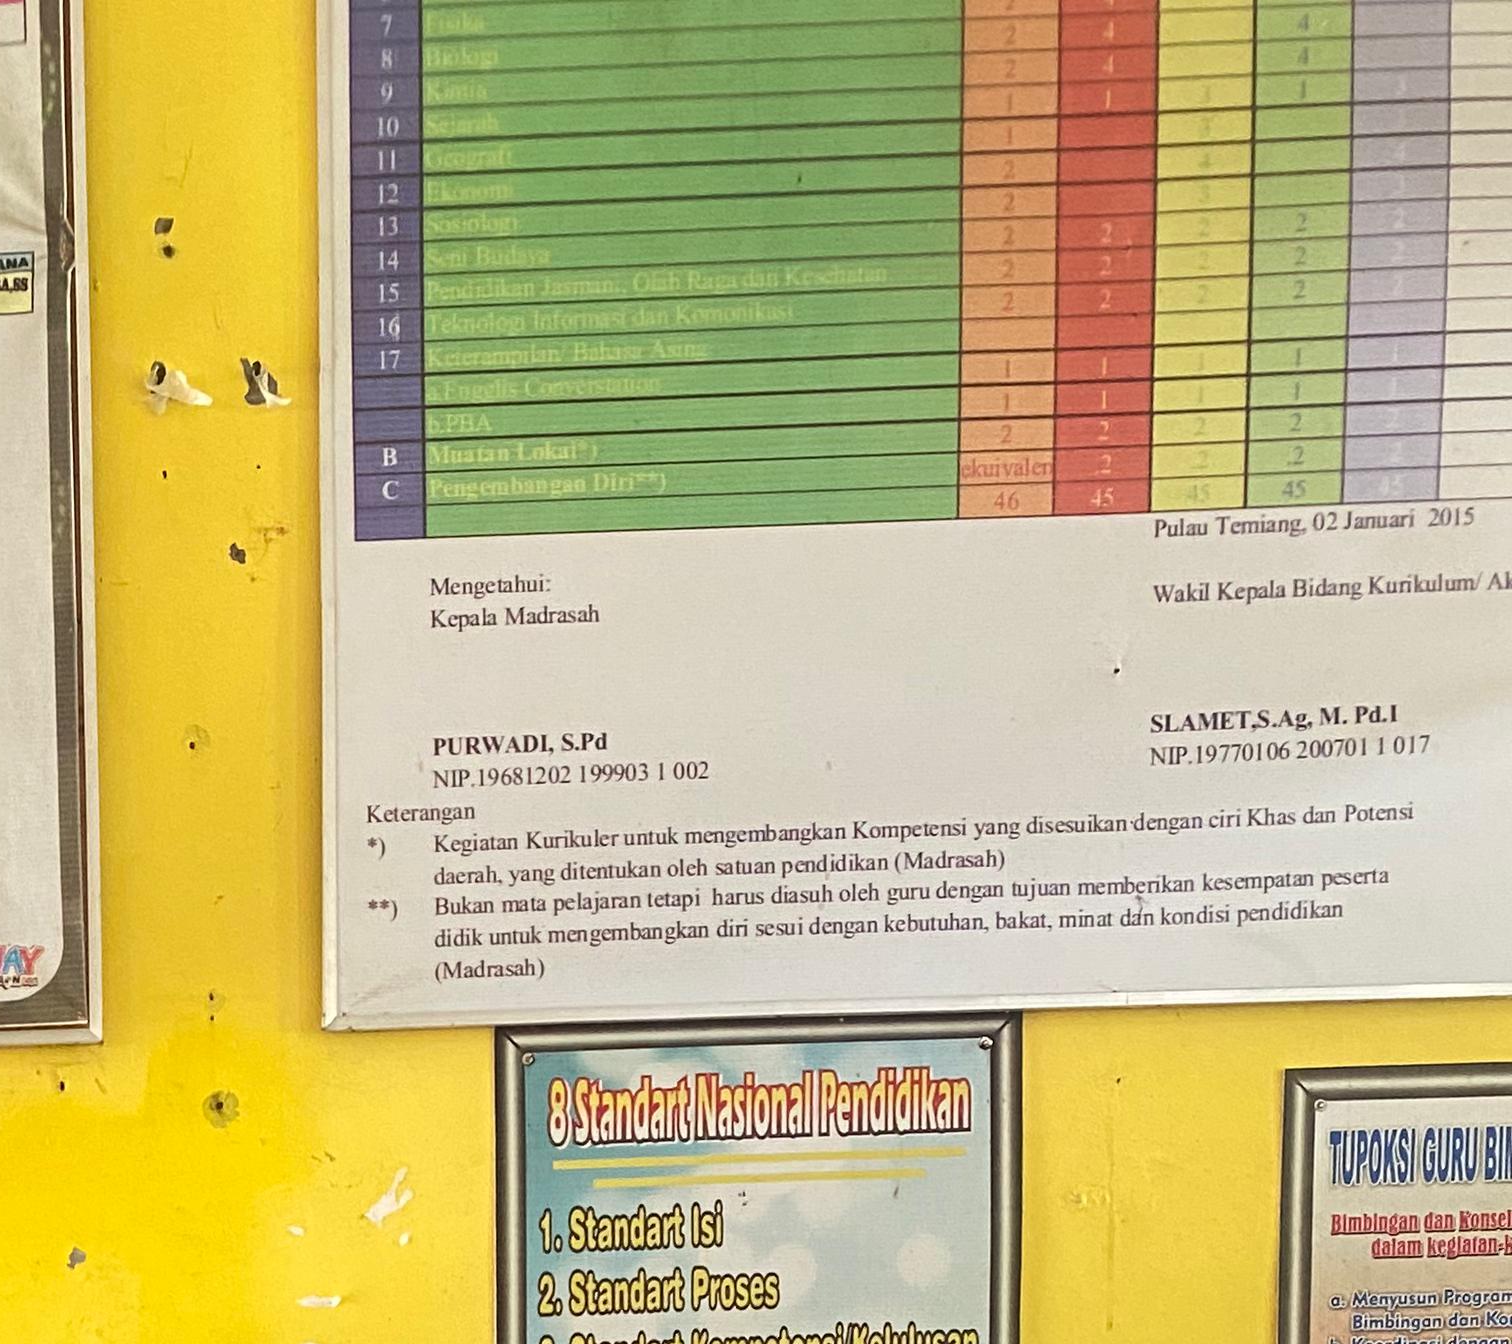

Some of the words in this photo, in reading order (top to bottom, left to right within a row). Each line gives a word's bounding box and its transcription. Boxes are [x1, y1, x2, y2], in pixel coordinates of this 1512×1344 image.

[378, 282, 400, 302] 15
[378, 350, 400, 370] 17
[383, 480, 399, 499] C
[431, 476, 586, 498] Pengembangan
[1155, 518, 1208, 538] Pulau
[1313, 513, 1337, 532] 02
[1343, 509, 1414, 530] Januari
[1427, 507, 1474, 527] 2015
[431, 574, 551, 599] Mengetahui:
[1153, 582, 1209, 603] Wakil
[1217, 579, 1286, 604] Kepala
[1292, 577, 1362, 599] Bidang
[1368, 571, 1482, 596] Kurikulum/
[431, 609, 496, 632] Kepala
[505, 605, 599, 625] Madrasah
[1319, 707, 1348, 726] M.
[1355, 704, 1397, 724] Pd.I
[433, 735, 554, 756] PURWADI,
[561, 733, 607, 751] S.Pd
[433, 766, 571, 788] NIP.19681202
[579, 763, 649, 784] 199903
[658, 763, 665, 780] 1
[674, 761, 709, 780] 002
[367, 804, 475, 826] Keterangan
[434, 866, 502, 886] daerah,
[508, 867, 555, 887] yang
[561, 862, 661, 881] ditentukan
[668, 858, 708, 877] oleh
[715, 861, 776, 876] satuan
[781, 853, 888, 878] pendidikan
[895, 849, 1006, 873] (Madrasah)
[435, 959, 545, 982] (Madrasah)
[548, 1077, 568, 1146] 8
[575, 1073, 690, 1145] Standart
[695, 1070, 814, 1139] Nasional
[820, 1066, 972, 1136] Pendidikan
[1329, 1127, 1417, 1186] TUPOKSI
[1423, 1127, 1478, 1183] GURU
[539, 1208, 563, 1253] 1.
[569, 1201, 685, 1252] Standart
[691, 1200, 724, 1248] Isi
[1331, 1214, 1419, 1235] Bimbingan
[1424, 1212, 1454, 1231] dan
[1371, 1239, 1422, 1258] dalam
[538, 1272, 563, 1316] 2.
[569, 1267, 684, 1316] Standart
[691, 1265, 779, 1310] Proses
[1353, 1292, 1437, 1311] Menyusun
